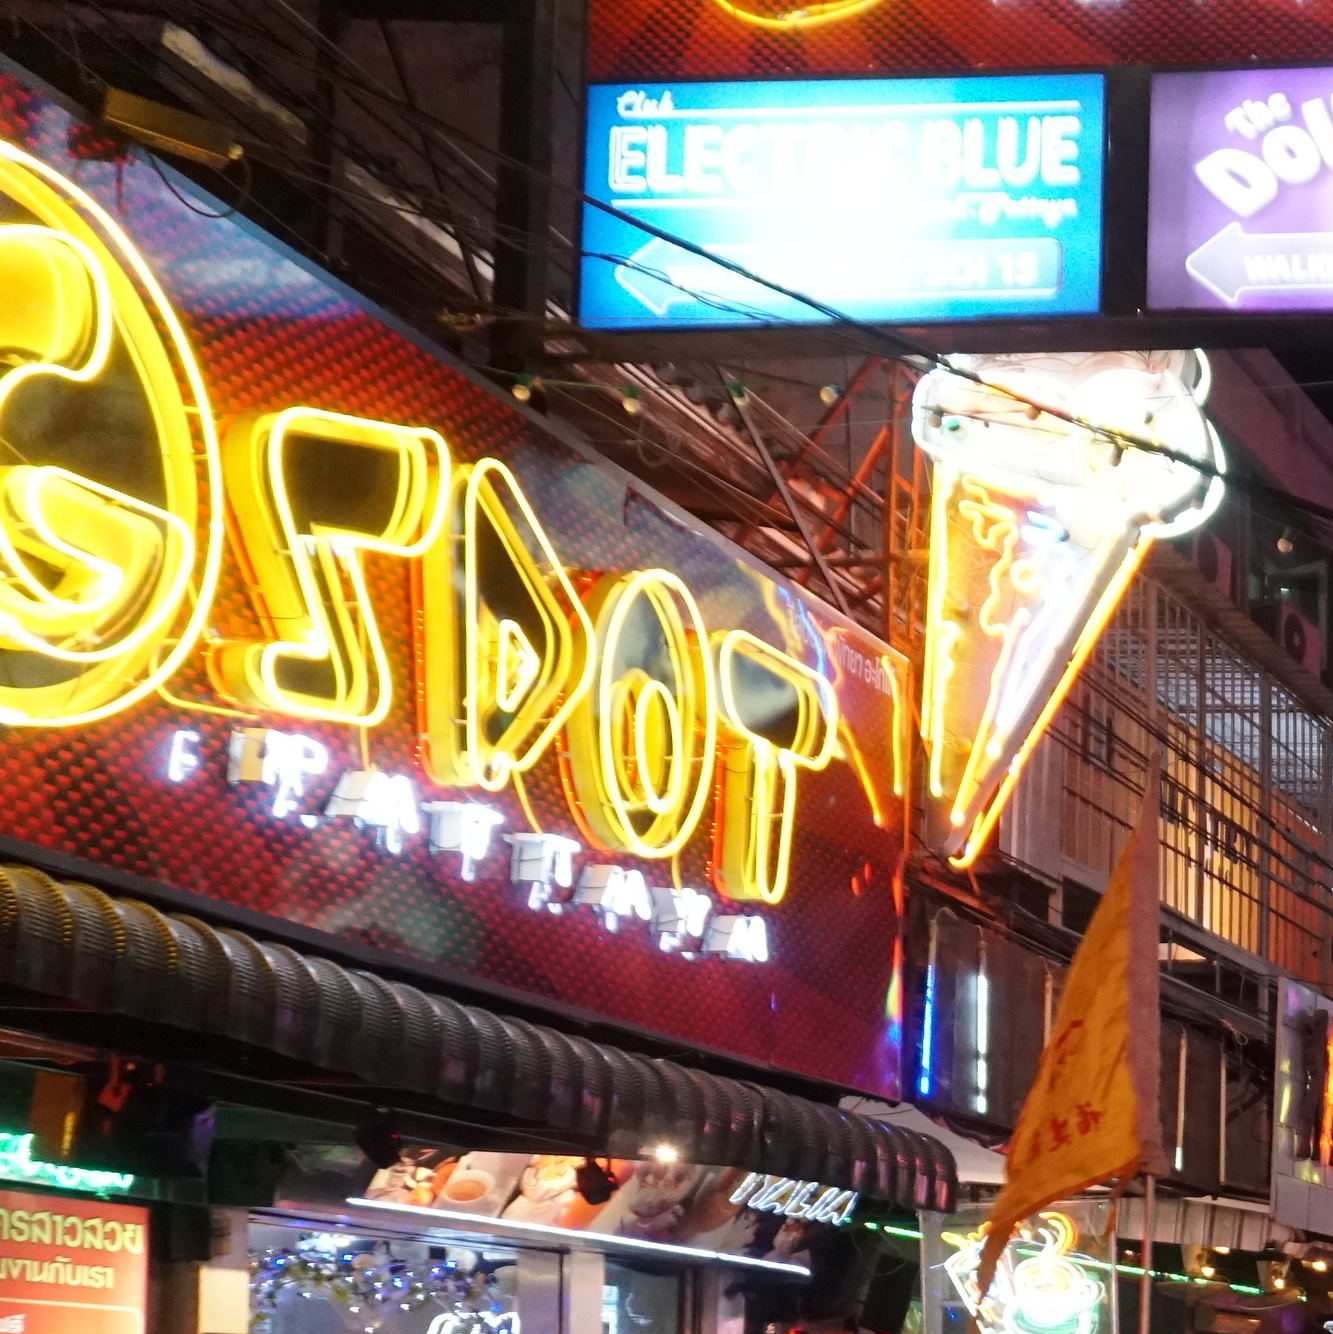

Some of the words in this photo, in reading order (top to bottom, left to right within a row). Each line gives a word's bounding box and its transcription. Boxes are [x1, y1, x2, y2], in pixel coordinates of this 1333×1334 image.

[1223, 92, 1293, 140] The
[919, 115, 1081, 188] BLUE
[922, 252, 988, 290] SOI
[996, 250, 1040, 286] 15
